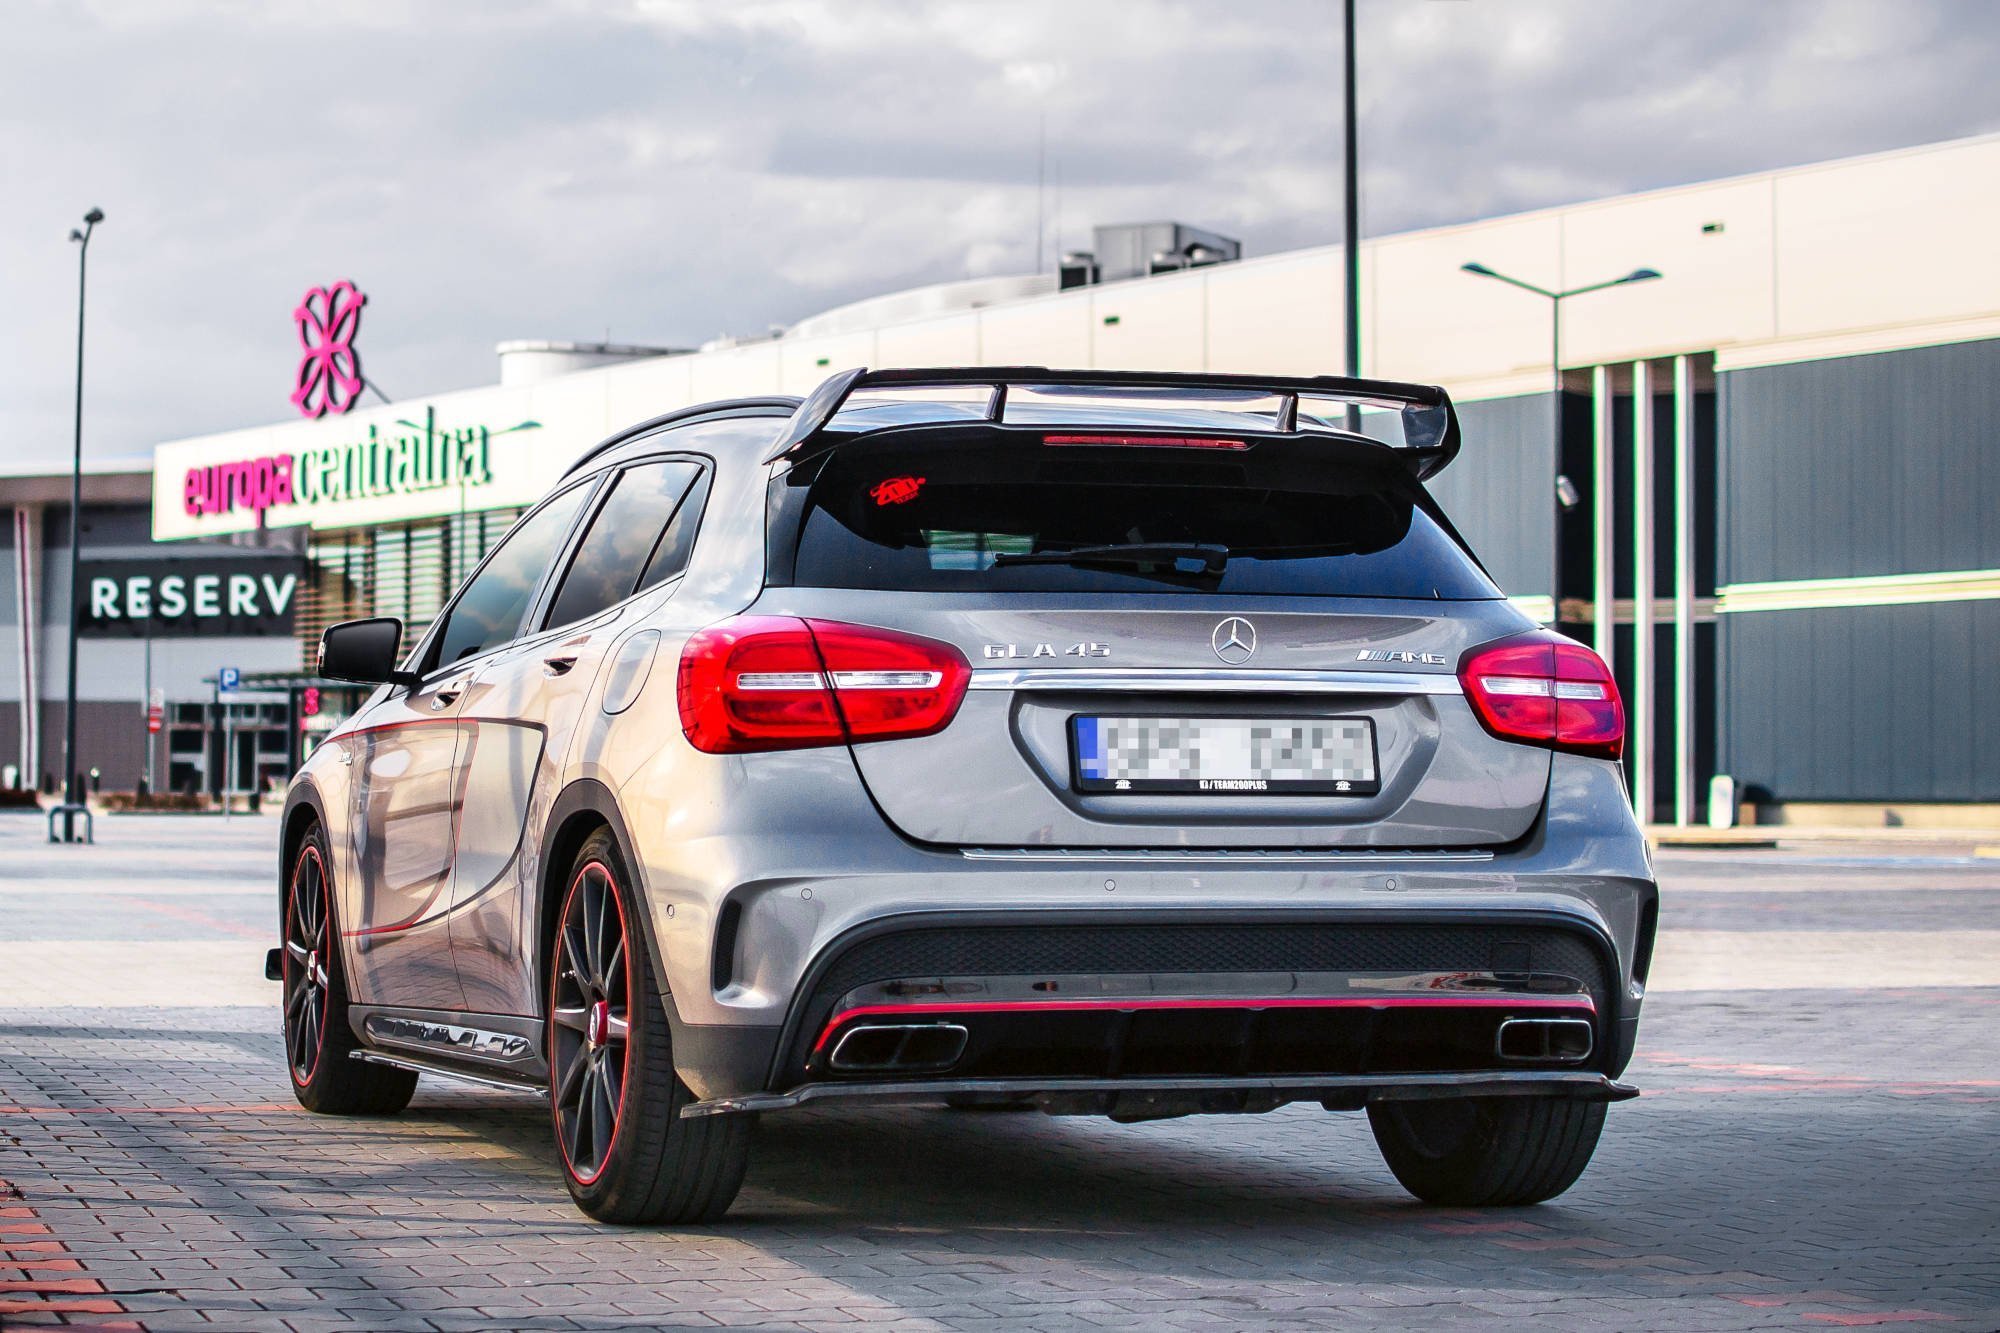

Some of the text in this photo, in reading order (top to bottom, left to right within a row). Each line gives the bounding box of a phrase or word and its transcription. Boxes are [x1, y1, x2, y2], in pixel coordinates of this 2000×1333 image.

[184, 453, 293, 528] europa
[90, 574, 296, 619] RESERV
[984, 642, 1111, 660] GLA 45
[223, 669, 236, 687] P
